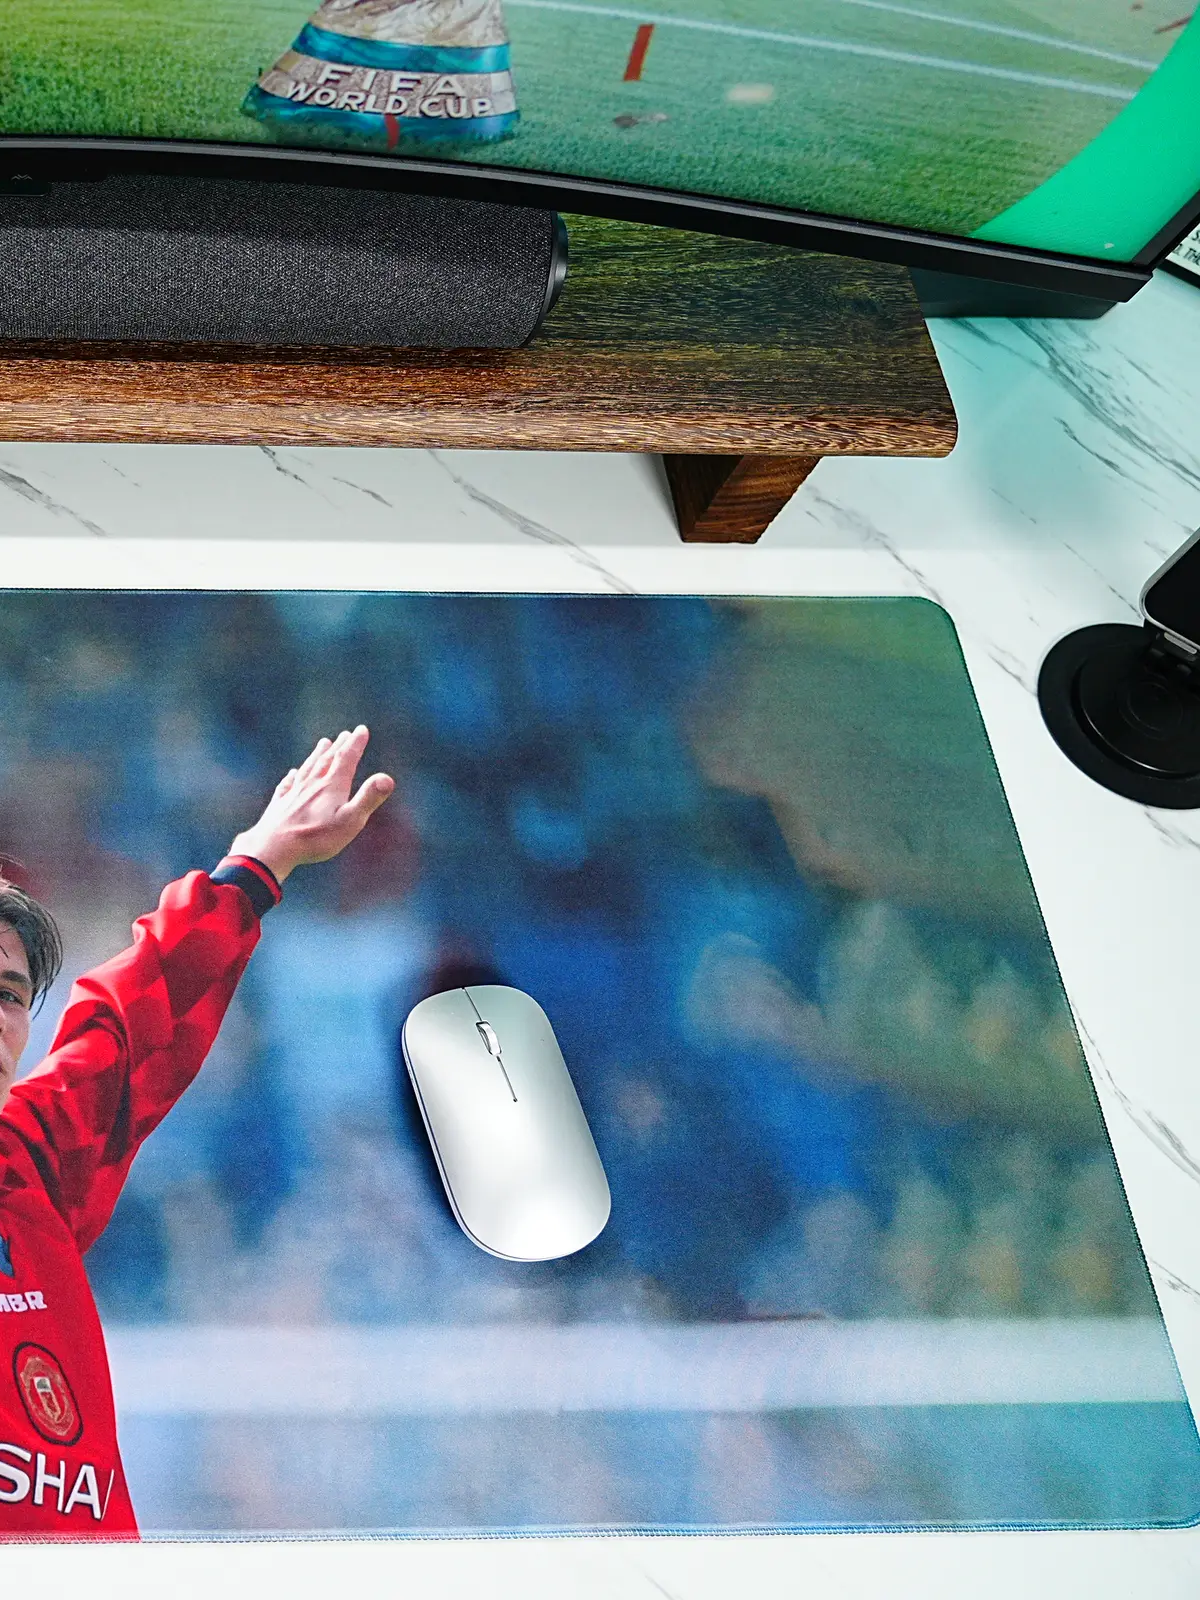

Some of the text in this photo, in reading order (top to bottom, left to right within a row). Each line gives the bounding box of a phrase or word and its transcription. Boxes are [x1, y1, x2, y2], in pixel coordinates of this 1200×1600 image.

[317, 64, 465, 97] FIFA
[286, 80, 493, 118] WORLD CUP
